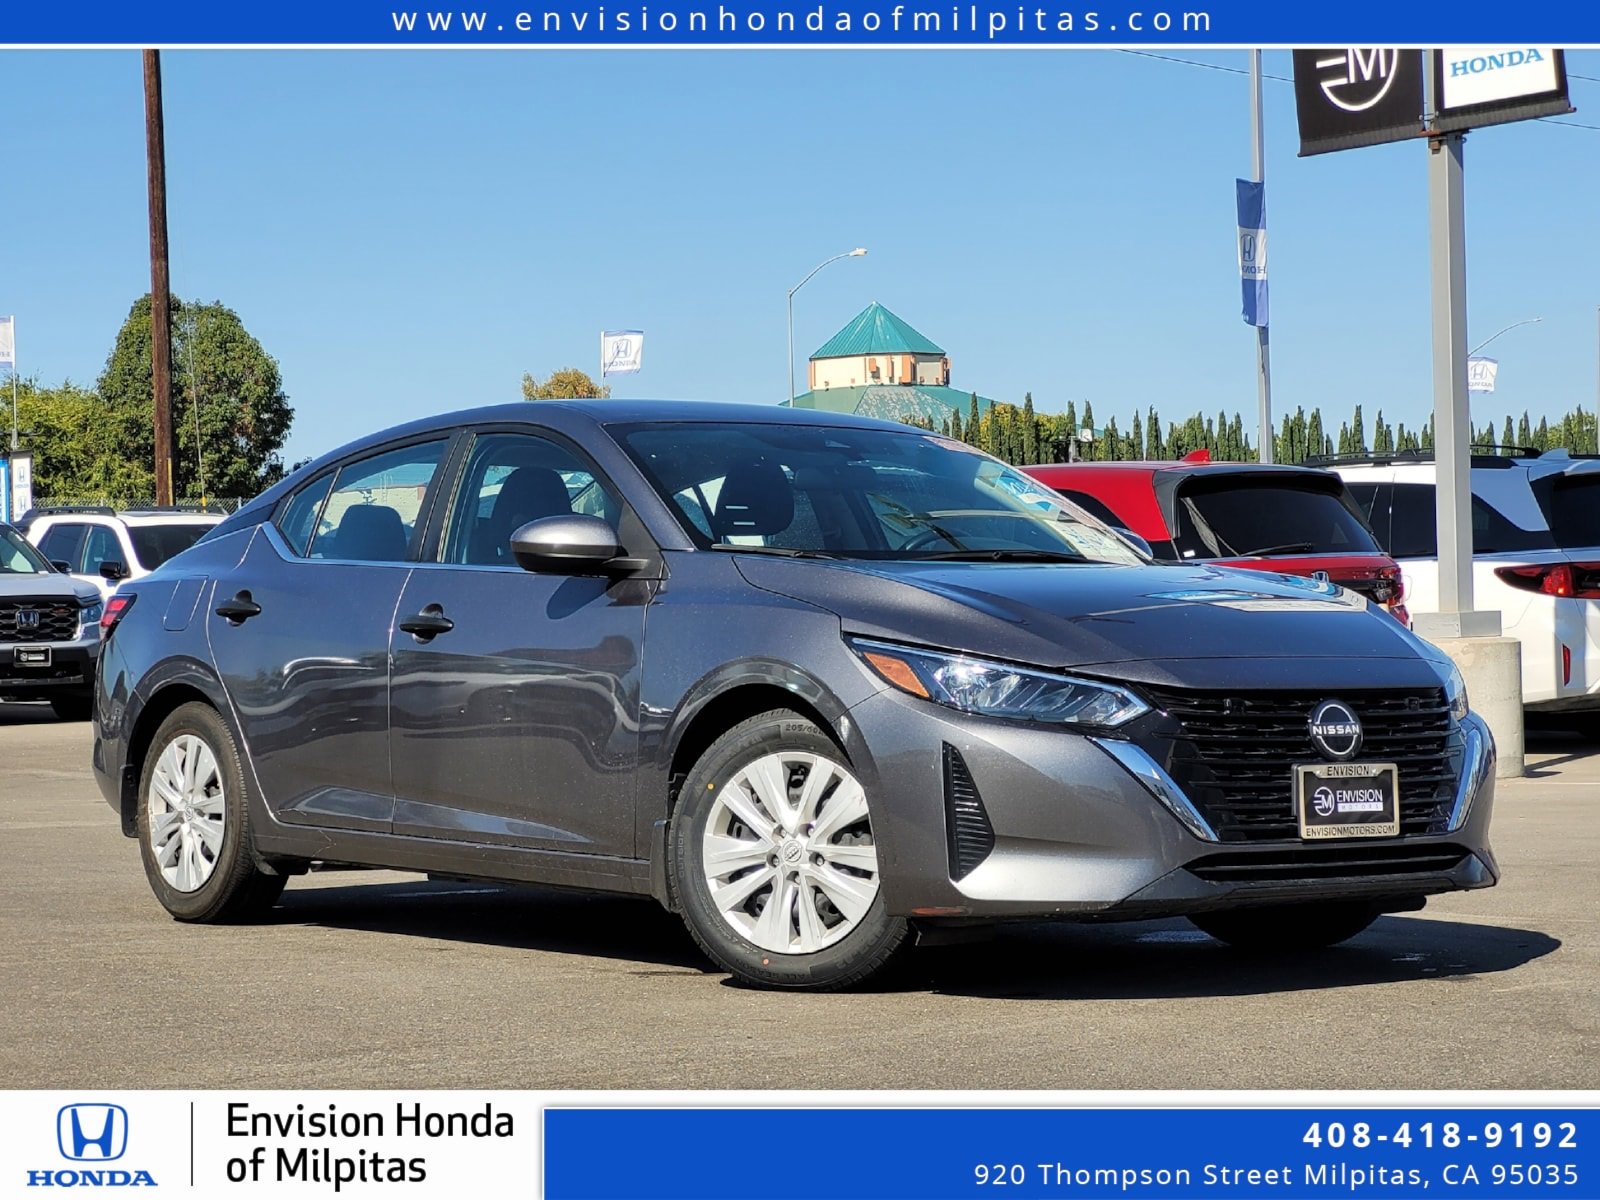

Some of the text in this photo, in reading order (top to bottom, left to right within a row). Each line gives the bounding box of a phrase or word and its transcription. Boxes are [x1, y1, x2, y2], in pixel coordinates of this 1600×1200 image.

[1450, 49, 1544, 77] HONDA
[1312, 724, 1360, 735] NISSAN
[1327, 765, 1370, 777] ENVISION
[1336, 789, 1383, 803] ENVISION
[1341, 803, 1380, 811] MOTORS
[1306, 825, 1395, 837] ENVISIONMOTORS.COM
